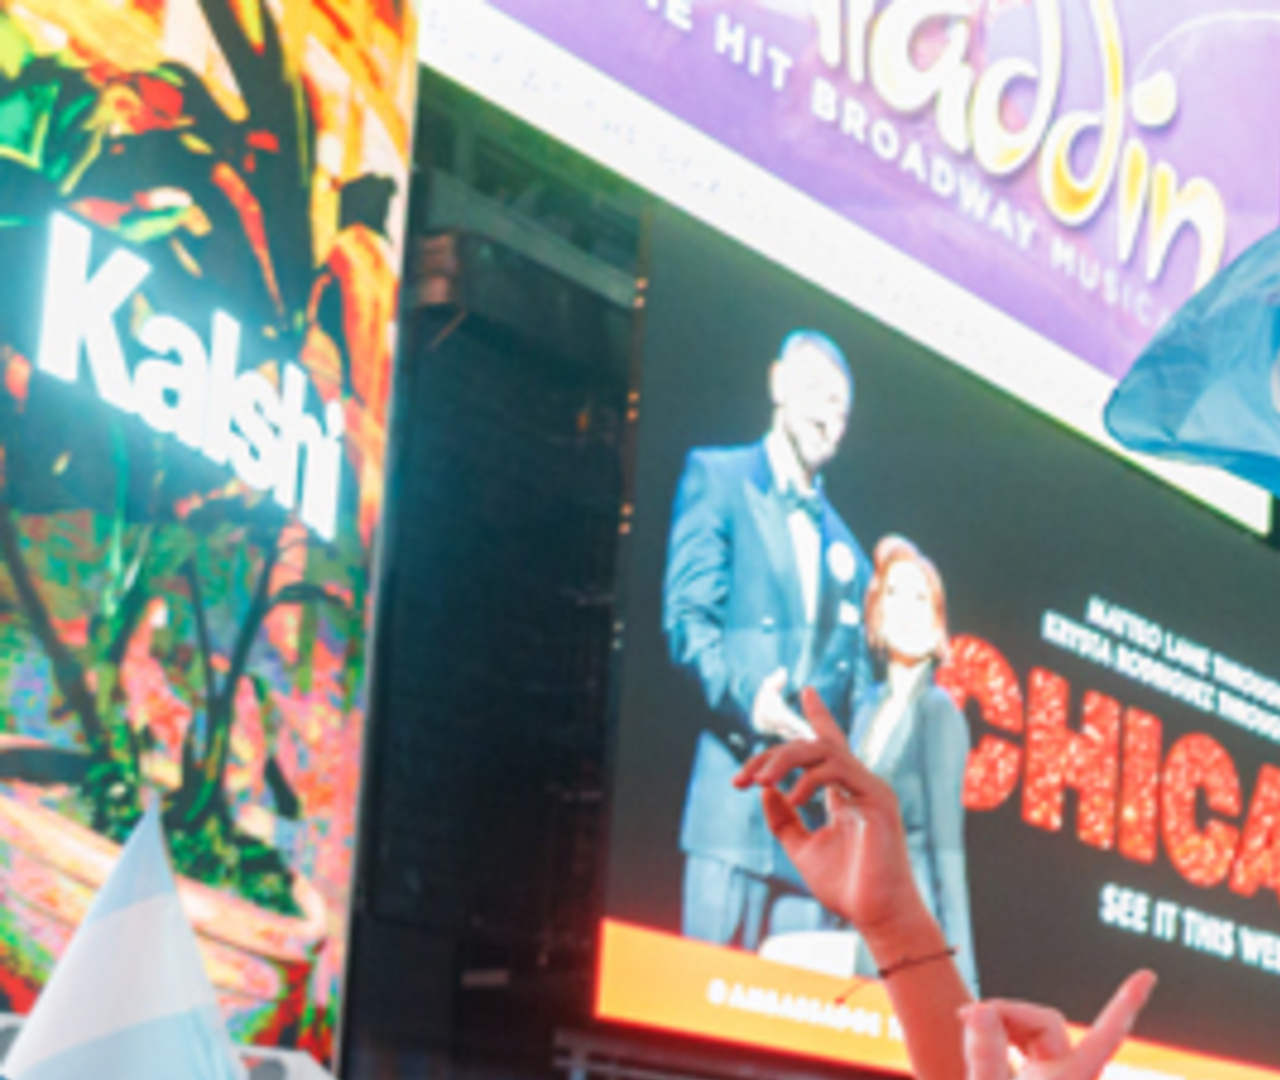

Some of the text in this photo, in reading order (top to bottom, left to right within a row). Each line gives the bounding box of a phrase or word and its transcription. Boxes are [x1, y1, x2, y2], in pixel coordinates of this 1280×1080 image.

[714, 12, 1173, 330] HIT BROADWAY MUSIC
[812, 0, 1222, 296] addin
[36, 209, 347, 543] Kalshi
[1100, 882, 1151, 934] SEE
[1151, 897, 1179, 942] IT
[1182, 906, 1236, 960] THIS
